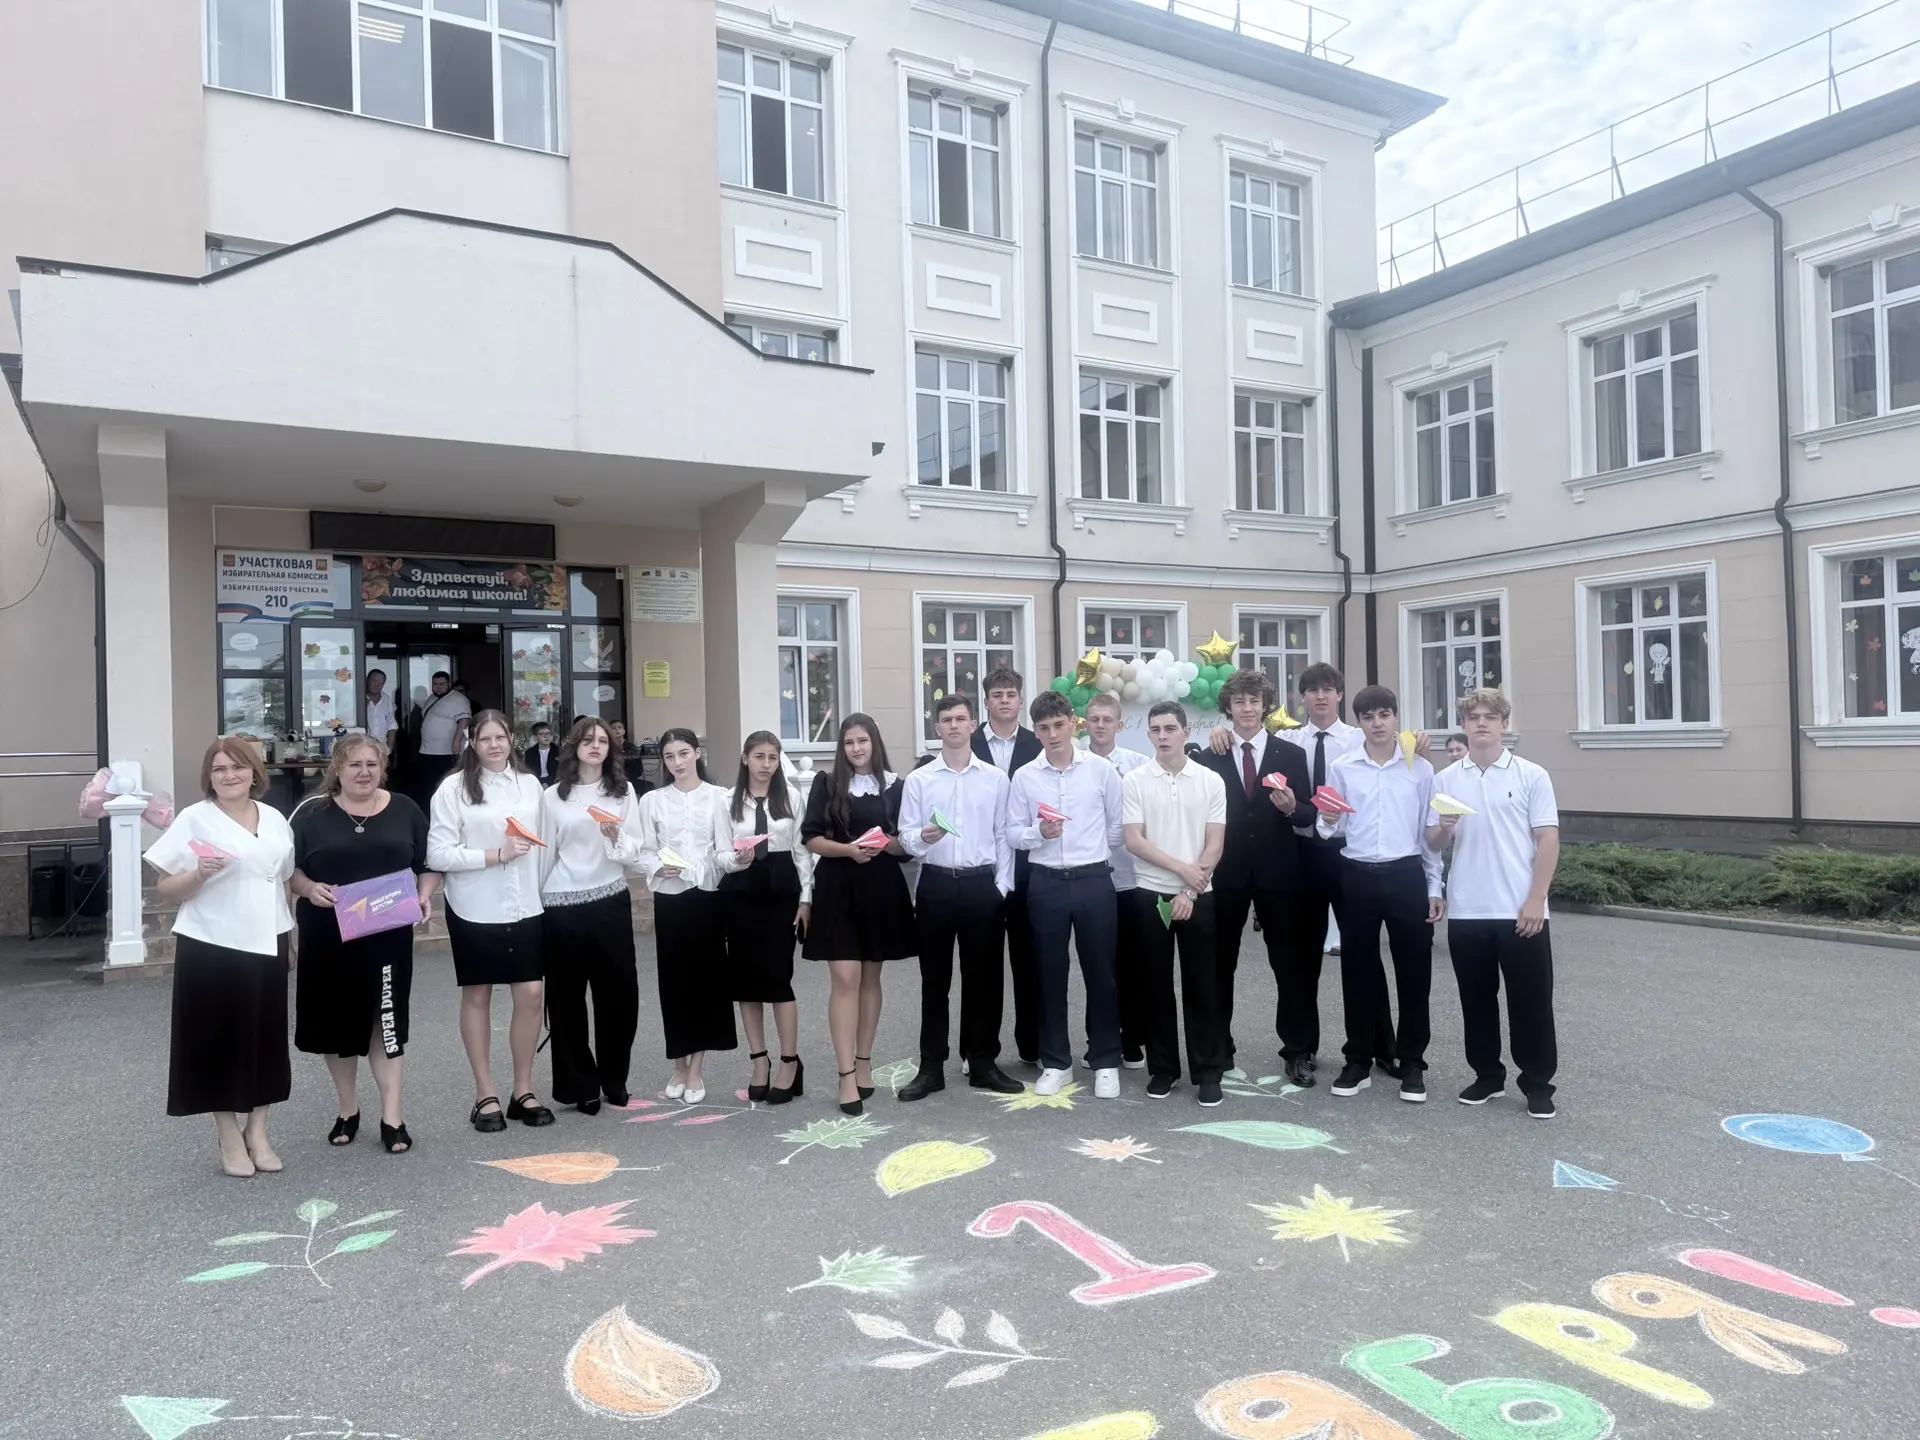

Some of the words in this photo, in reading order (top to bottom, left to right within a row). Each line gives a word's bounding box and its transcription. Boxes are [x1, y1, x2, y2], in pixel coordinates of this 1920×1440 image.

[239, 556, 313, 570] УЧАСТКОВАЯ
[222, 569, 286, 579] ИЗБИРАТЕЛЬНАЯ
[287, 572, 328, 581] КОМИССИЯ
[411, 568, 509, 587] Здравствуй,
[222, 584, 287, 593] ИЗБИРАТЕЛЬНОГО
[391, 585, 469, 600] любимая
[471, 588, 528, 601] школа!
[265, 594, 289, 608] 210
[380, 964, 393, 1010] DUPER
[381, 1011, 399, 1054] SUPER
